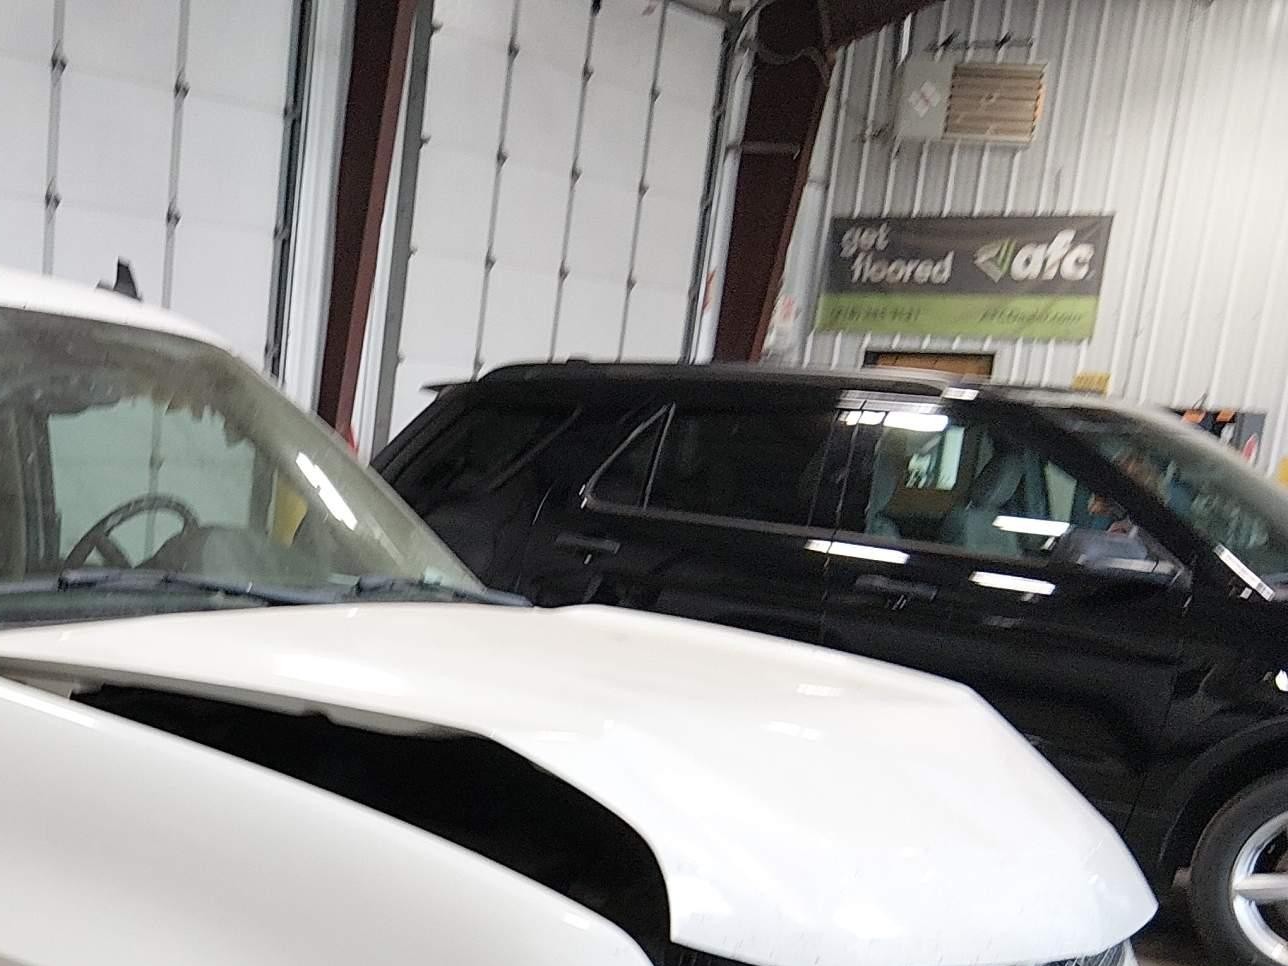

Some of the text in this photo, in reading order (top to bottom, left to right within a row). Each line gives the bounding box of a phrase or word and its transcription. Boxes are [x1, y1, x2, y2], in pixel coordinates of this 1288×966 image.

[839, 222, 891, 257] get
[1011, 228, 1095, 281] afc
[851, 250, 954, 284] floored
